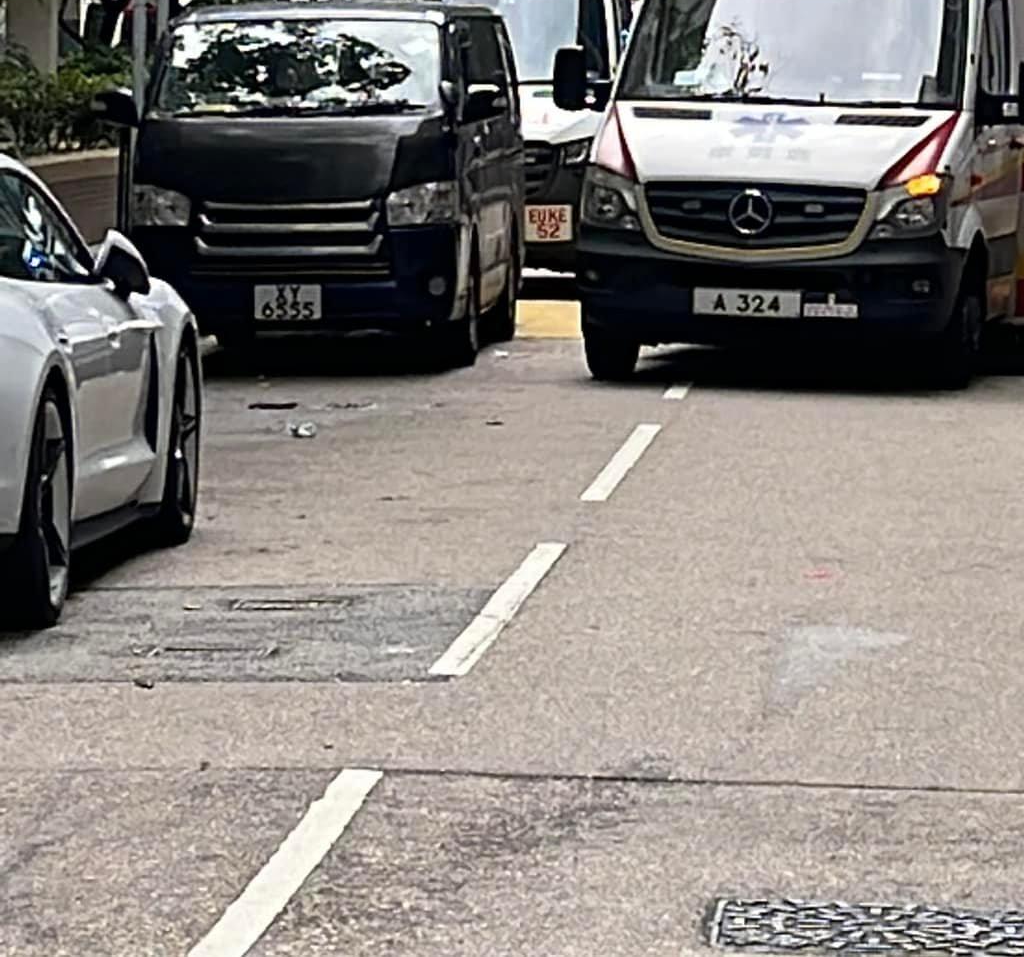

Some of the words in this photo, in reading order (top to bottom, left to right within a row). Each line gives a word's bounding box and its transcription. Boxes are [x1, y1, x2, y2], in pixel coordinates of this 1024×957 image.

[262, 301, 314, 319] 6555
[713, 293, 726, 312] A
[736, 294, 781, 314] 324
